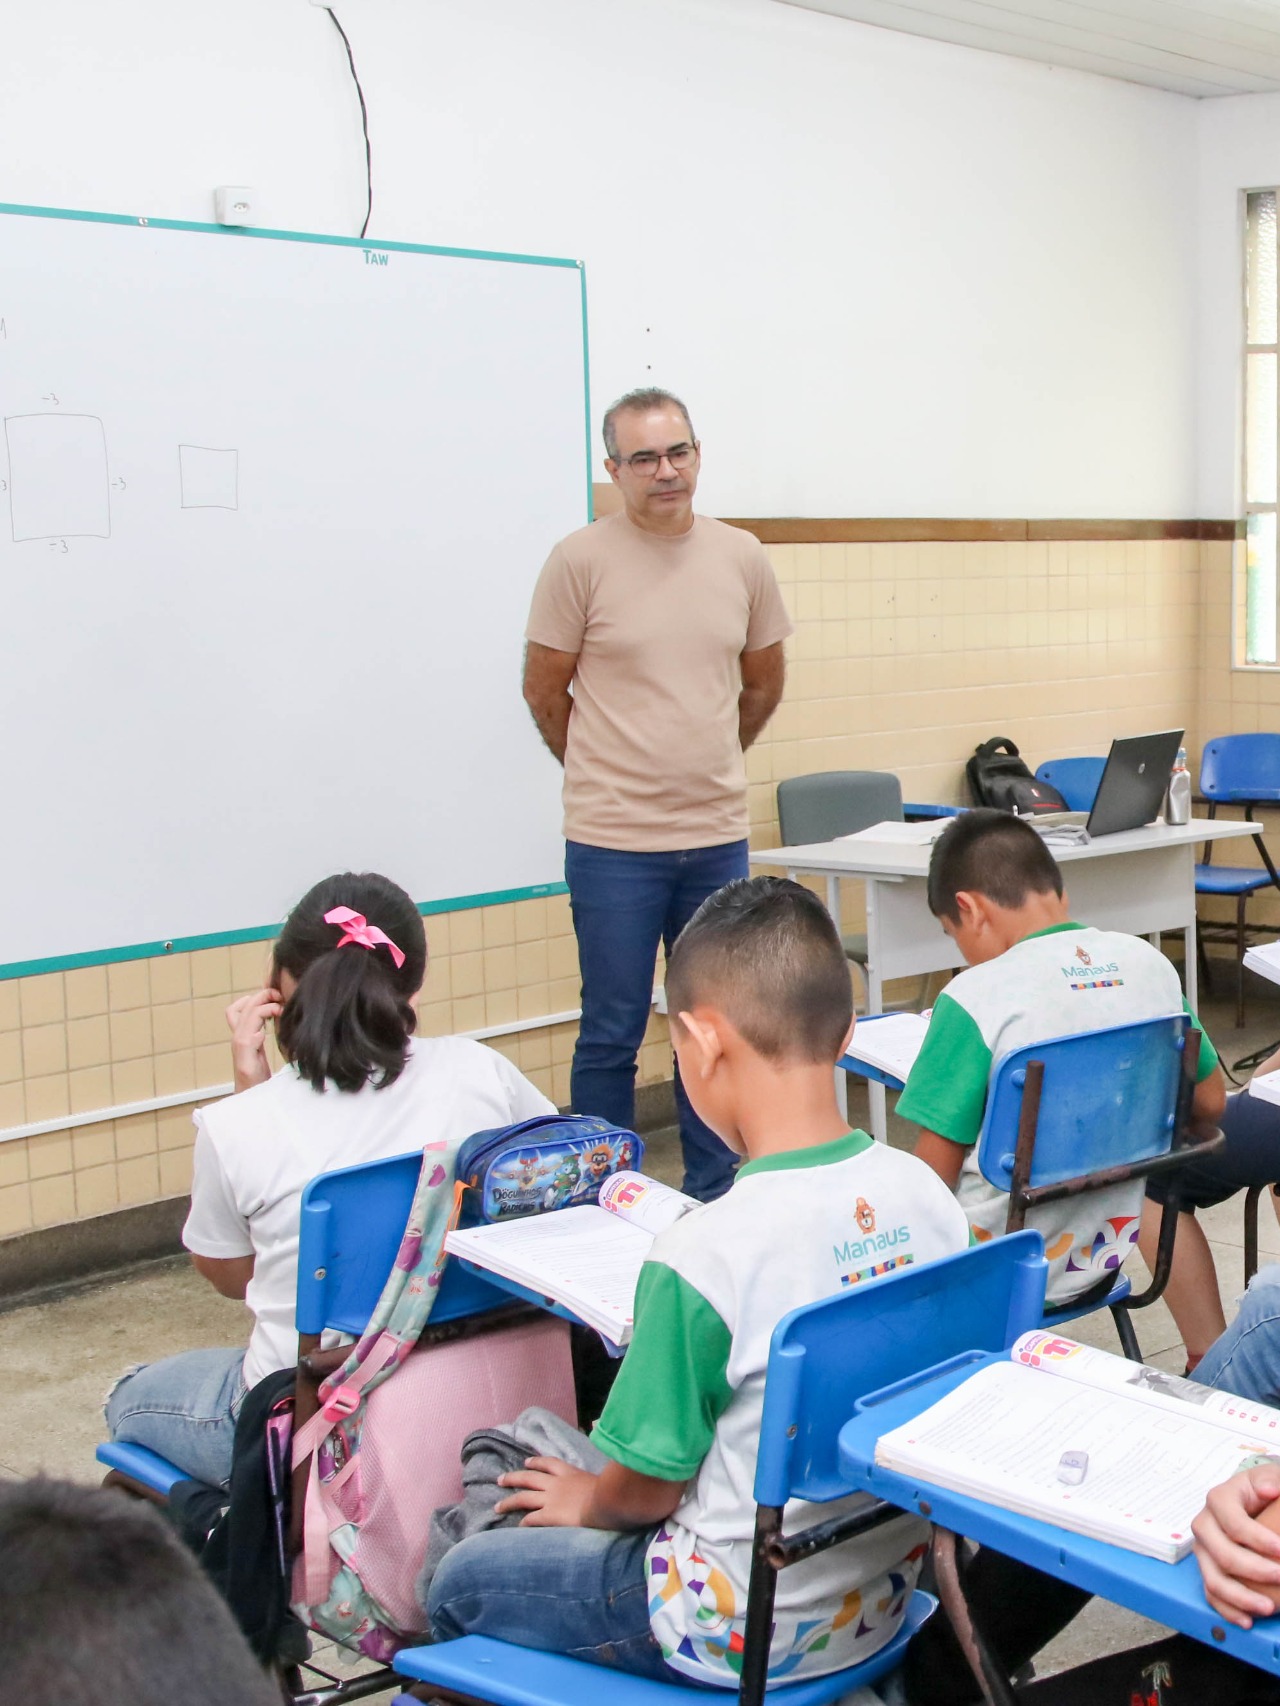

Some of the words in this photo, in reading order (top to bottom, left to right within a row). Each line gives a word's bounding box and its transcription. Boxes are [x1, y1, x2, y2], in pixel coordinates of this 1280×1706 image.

[362, 249, 389, 266] TAW
[1061, 962, 1119, 978] Manaus
[618, 1182, 646, 1204] 11
[833, 1225, 911, 1266] Manaus
[1042, 1339, 1079, 1356] 11
